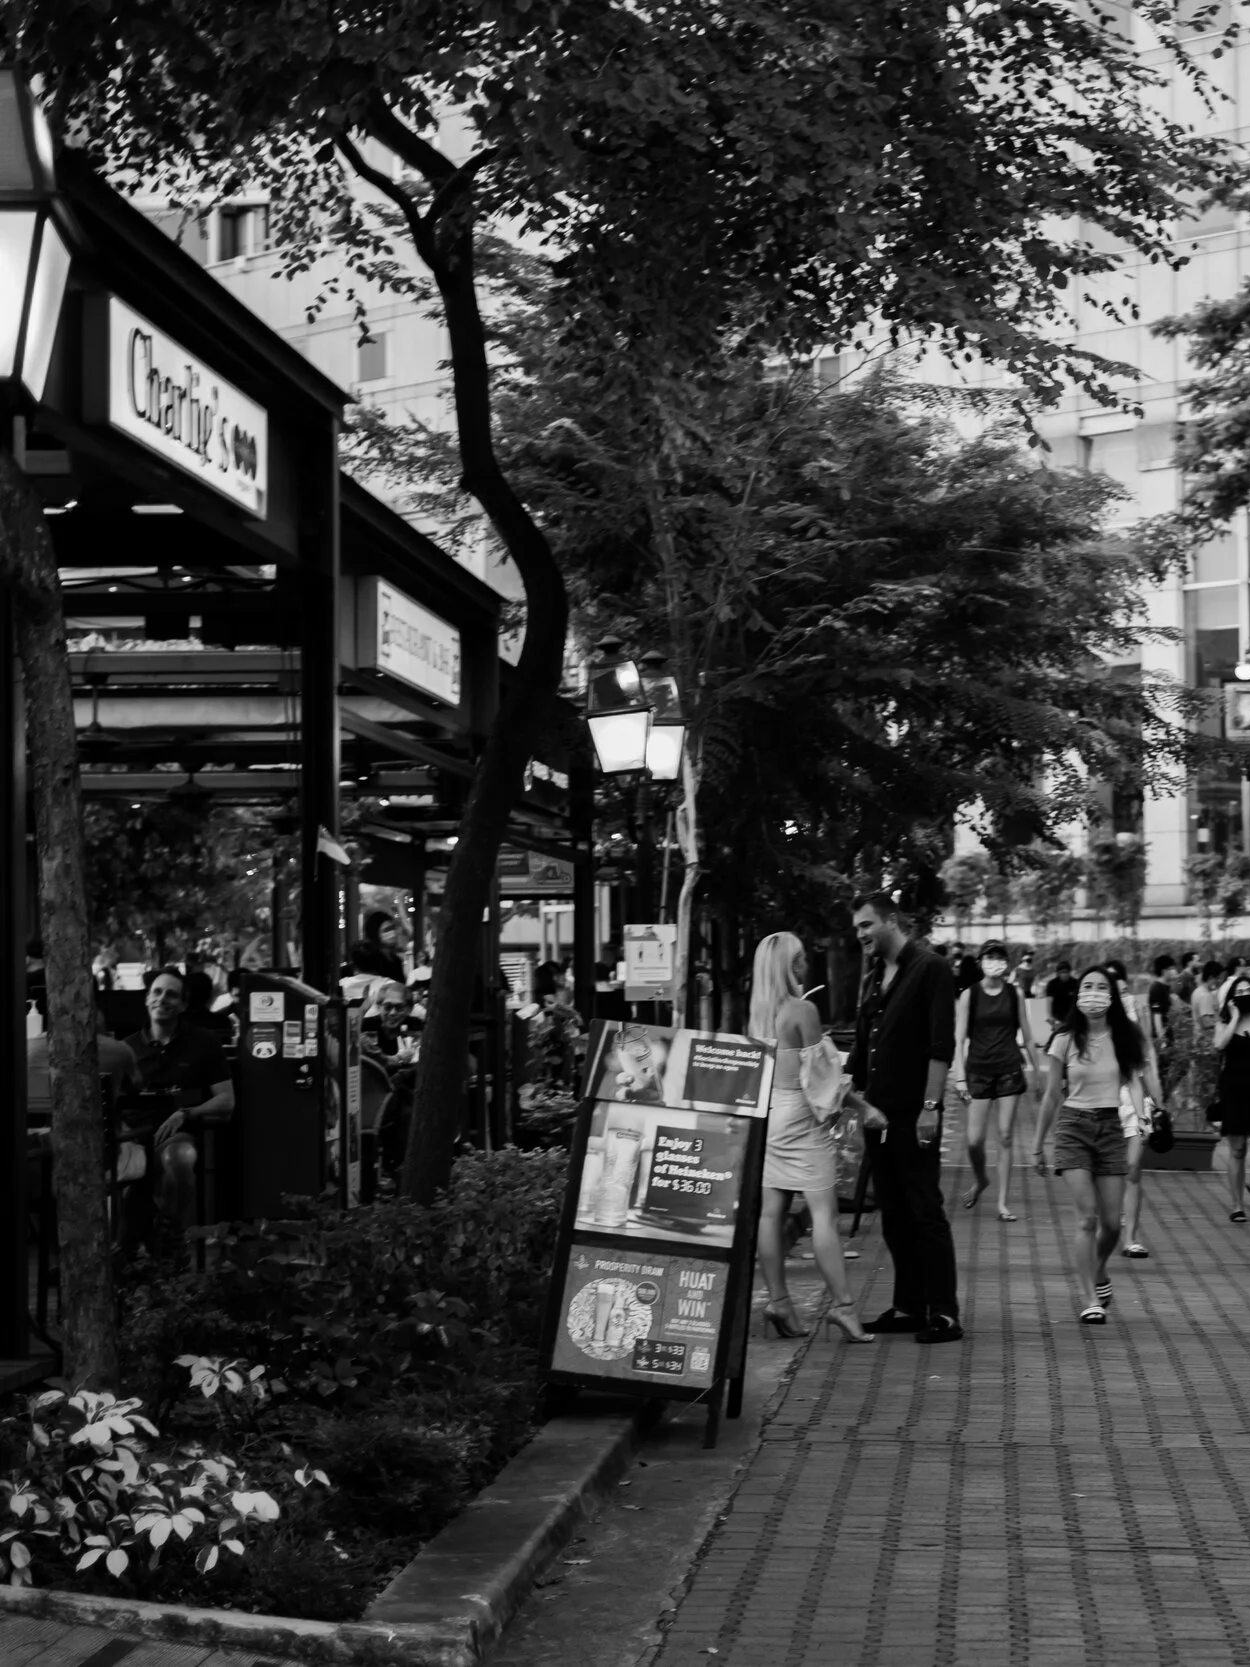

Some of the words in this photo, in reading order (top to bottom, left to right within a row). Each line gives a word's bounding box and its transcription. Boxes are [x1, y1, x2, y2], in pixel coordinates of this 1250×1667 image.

[127, 327, 229, 473] Charlie's
[696, 1044, 735, 1057] Welcome
[658, 1136, 692, 1151] Enjoy
[694, 1139, 703, 1151] 3
[655, 1150, 700, 1164] glasses
[653, 1164, 668, 1174] of
[651, 1176, 671, 1188] for
[671, 1179, 712, 1195] $36.00
[594, 1259, 641, 1274] PROSPERITY
[641, 1264, 664, 1277] DRAW
[678, 1270, 716, 1291] HUAT
[686, 1289, 704, 1300] AND
